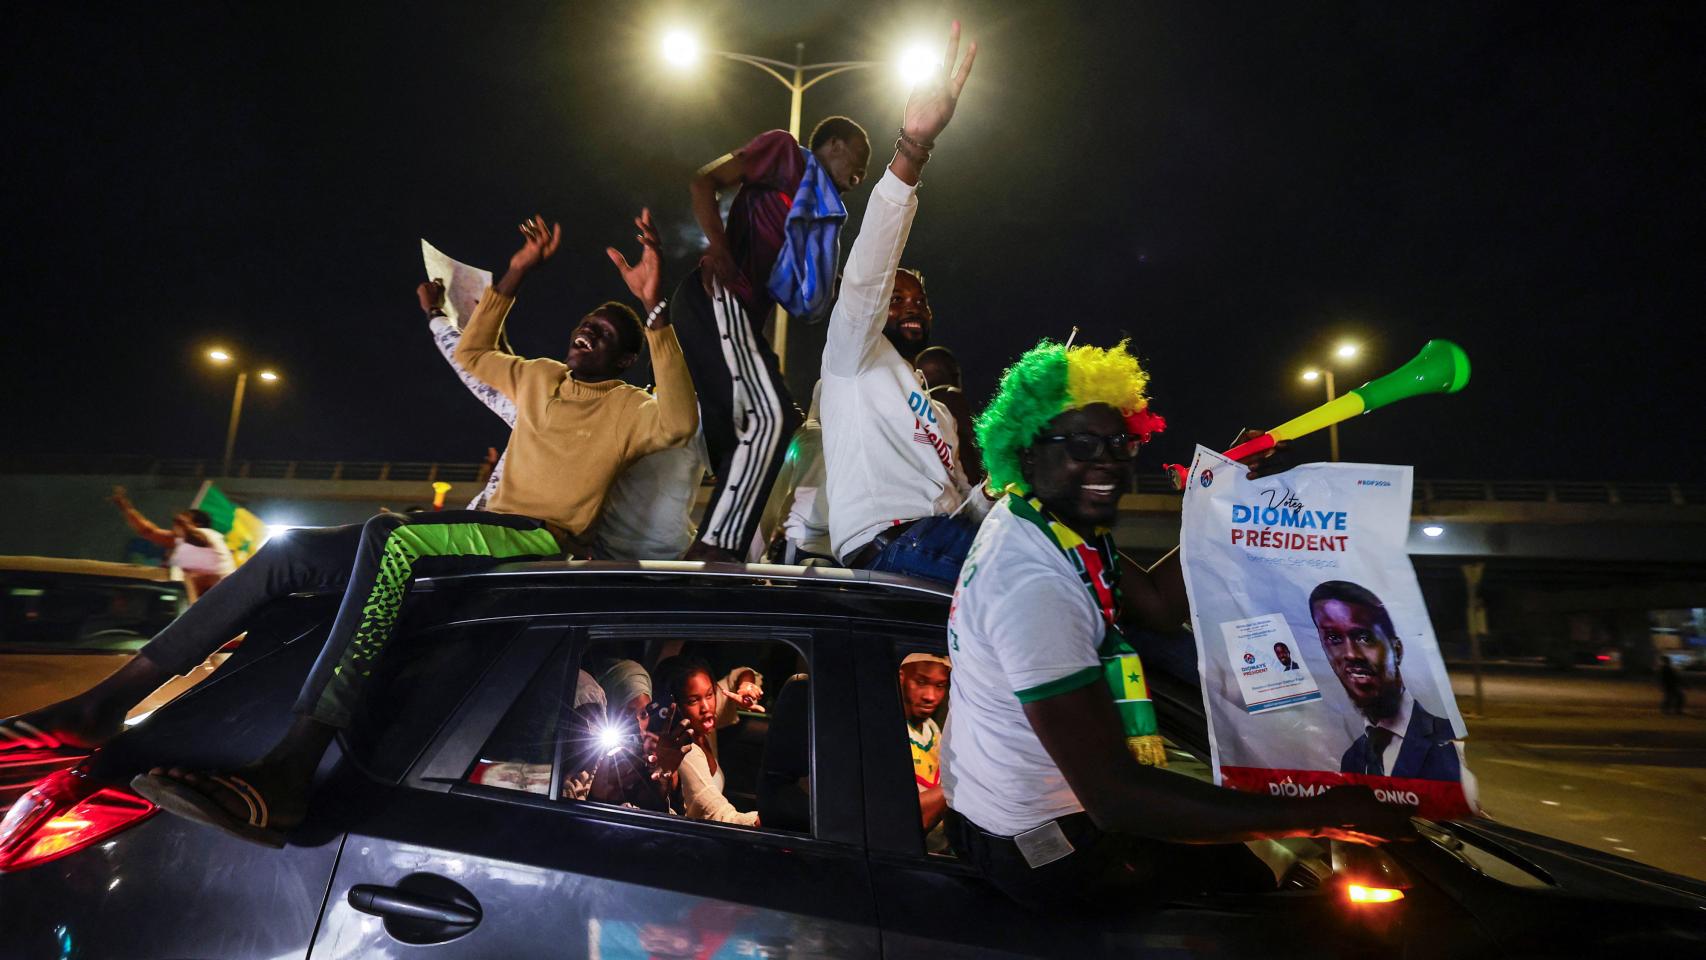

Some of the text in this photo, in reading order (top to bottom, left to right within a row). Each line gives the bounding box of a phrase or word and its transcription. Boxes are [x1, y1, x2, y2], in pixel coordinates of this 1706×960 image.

[1260, 488, 1304, 512] Votez
[1231, 504, 1348, 531] DIOMAYE
[1231, 527, 1349, 552] PRÉSIDENT
[1268, 782, 1420, 806] DIOMA ONKO
